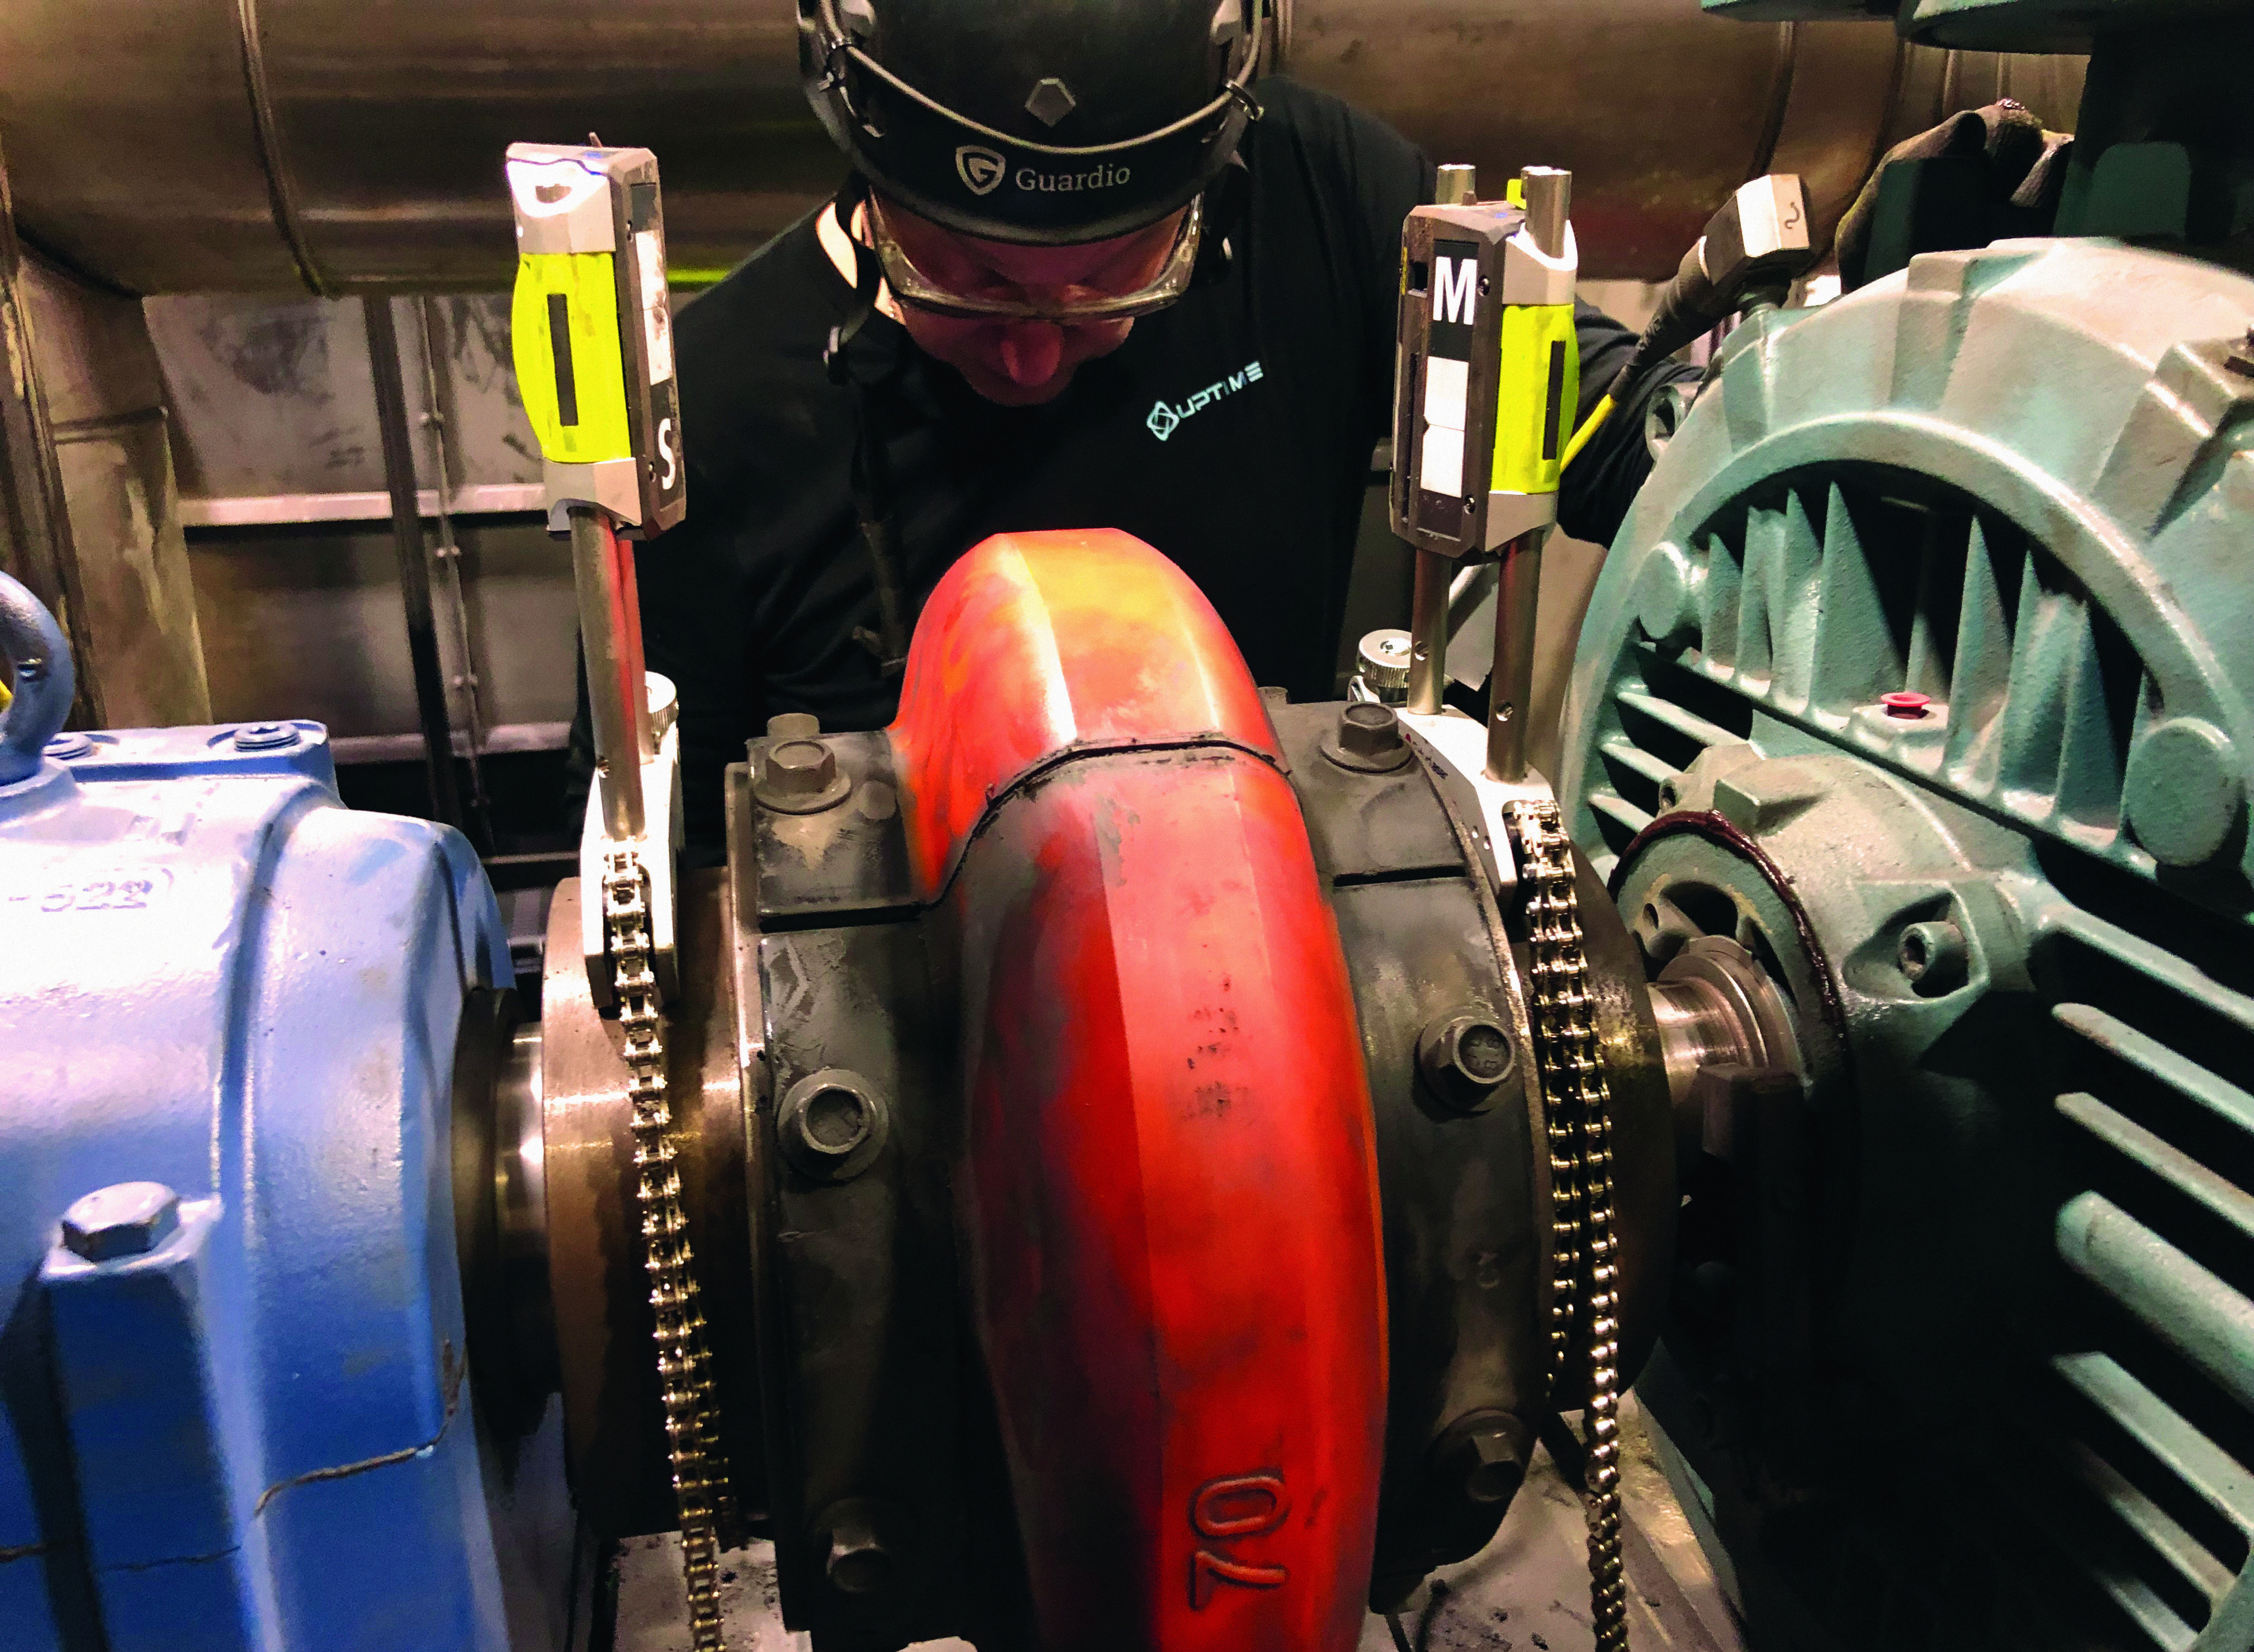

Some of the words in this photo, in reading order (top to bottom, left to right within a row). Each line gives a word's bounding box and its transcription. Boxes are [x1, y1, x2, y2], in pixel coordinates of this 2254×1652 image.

[1016, 163, 1131, 192] Guardio
[1432, 255, 1478, 326] M
[1175, 361, 1263, 419] UPTIME
[658, 418, 676, 490] S
[1187, 1470, 1290, 1611] 70
